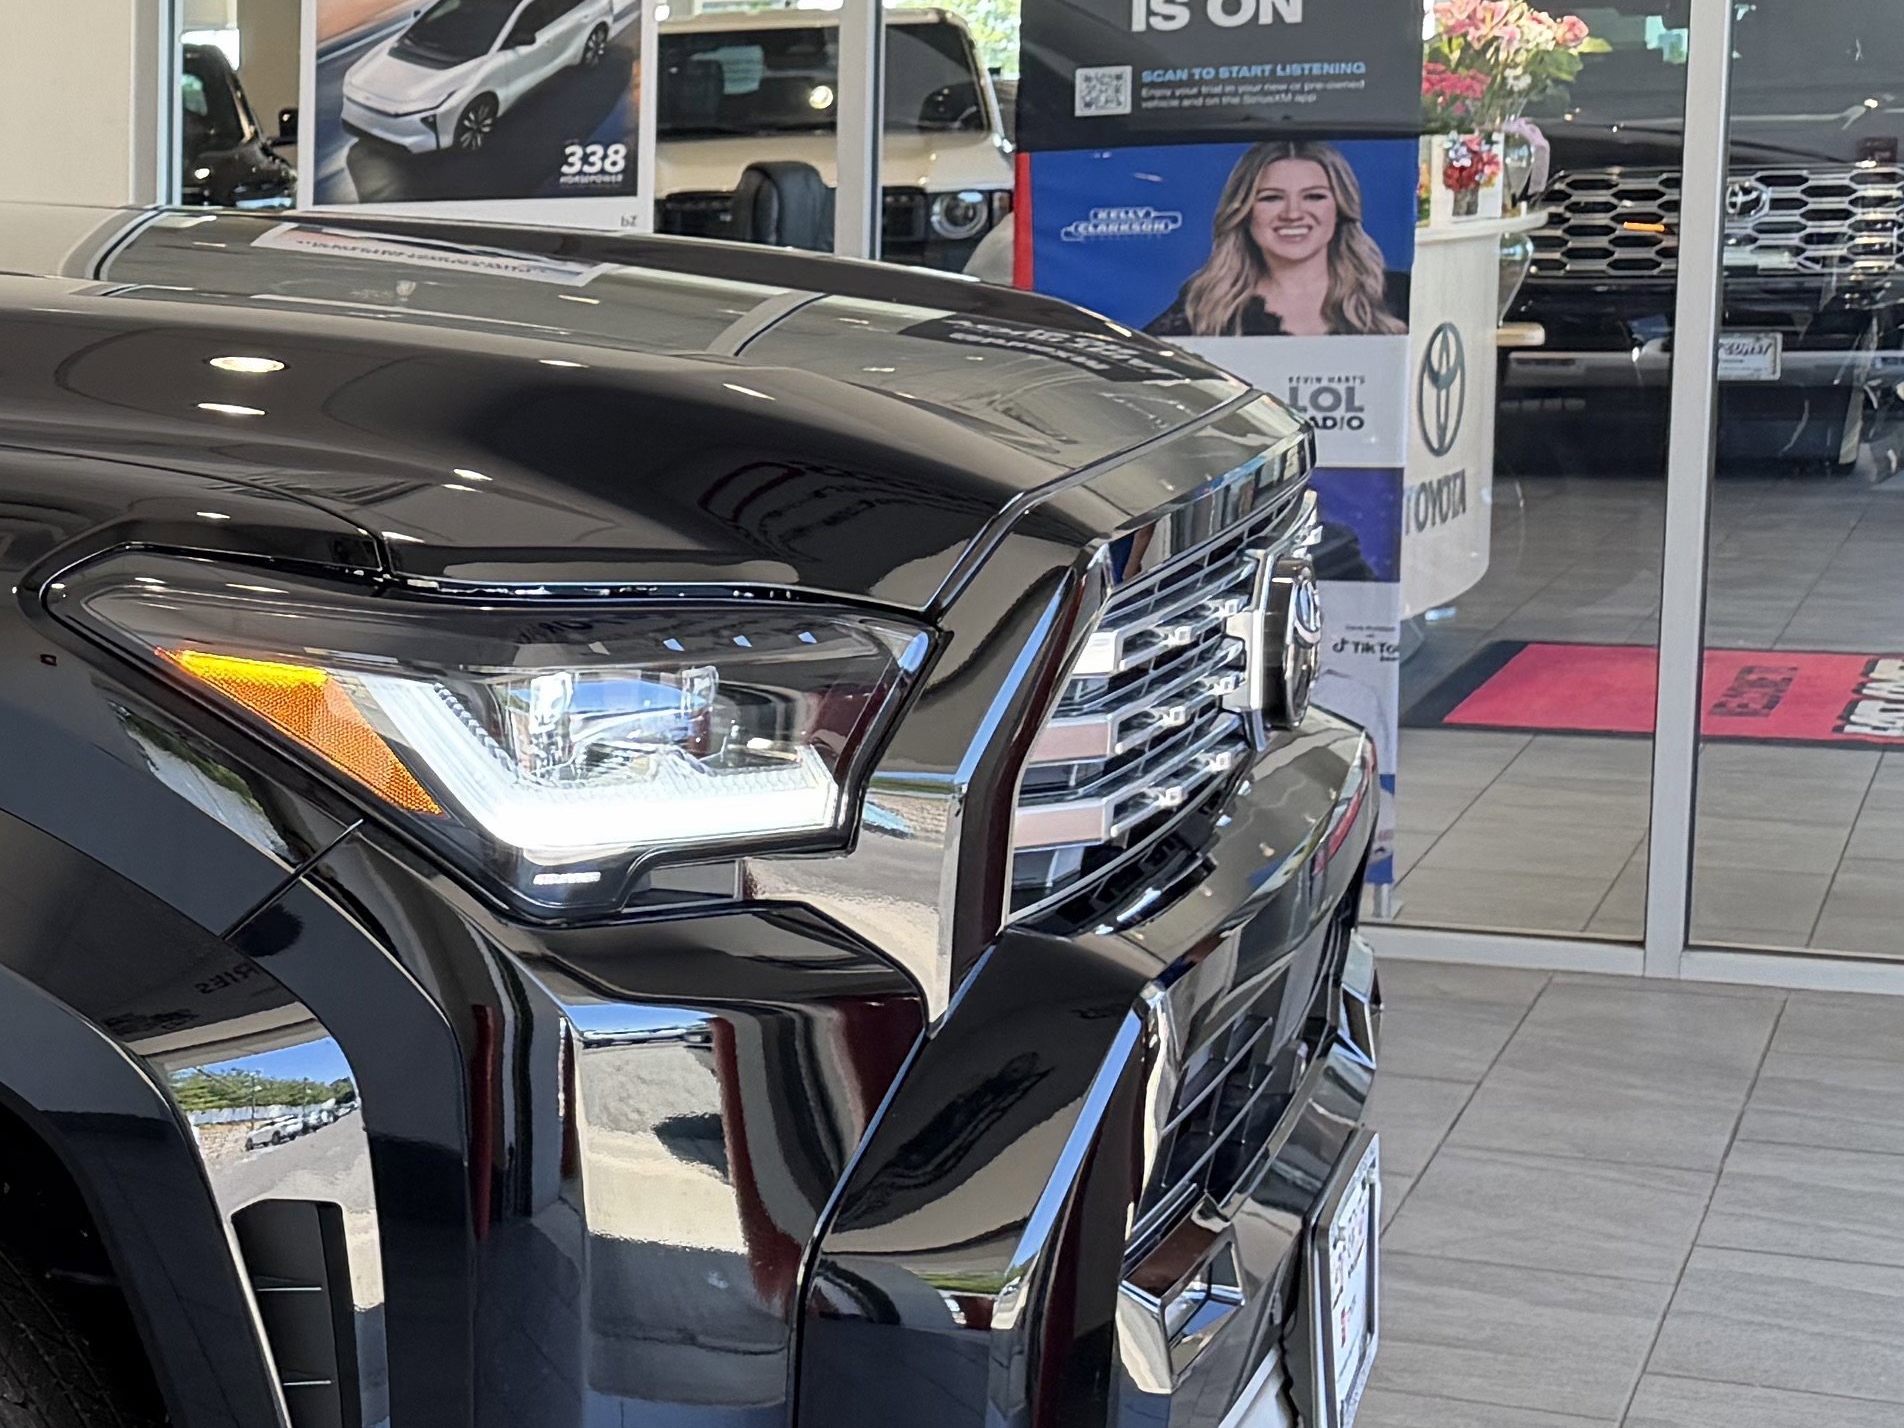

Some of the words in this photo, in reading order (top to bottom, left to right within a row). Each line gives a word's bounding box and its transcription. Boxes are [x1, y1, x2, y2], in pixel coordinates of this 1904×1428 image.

[1142, 68, 1188, 83] SCAN
[1192, 67, 1215, 81] TO
[1219, 64, 1274, 80] START
[1276, 61, 1367, 76] LISTENING
[560, 143, 627, 174] 338
[1289, 386, 1365, 413] LOL
[1308, 416, 1365, 431] ADIO
[1403, 468, 1467, 537] TOYOTA
[1351, 640, 1400, 655] TikTo
